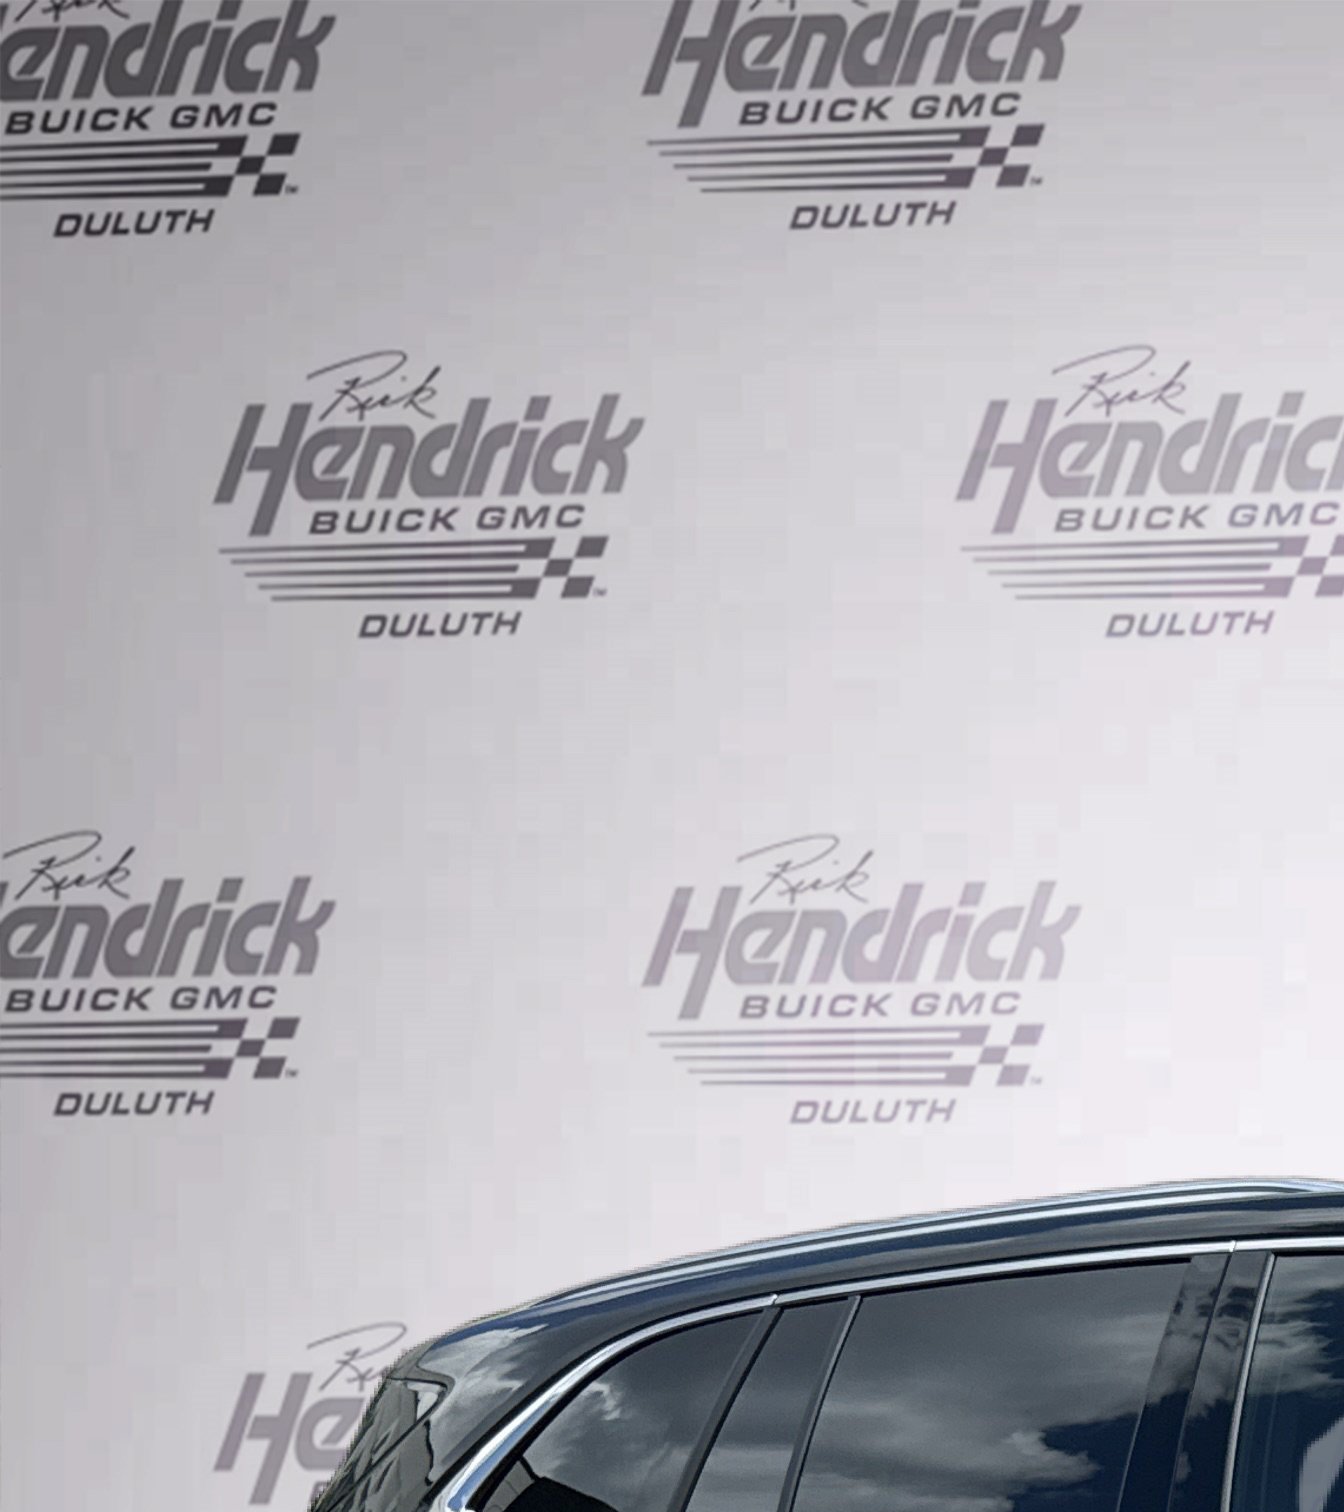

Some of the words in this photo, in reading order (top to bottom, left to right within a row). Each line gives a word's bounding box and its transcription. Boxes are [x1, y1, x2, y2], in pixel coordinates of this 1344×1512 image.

[0, 0, 336, 101] endrick
[641, 0, 1082, 128] Hendrick
[4, 106, 152, 135] BUICK
[168, 102, 278, 129] GMC
[739, 96, 893, 125] BUICK
[909, 93, 1022, 118] GMC
[53, 209, 215, 237] DULUTH
[789, 201, 957, 230] DULUTH
[212, 393, 646, 537] Hendrick
[309, 507, 460, 535] BUICK
[476, 504, 585, 530] GMC
[1054, 505, 1210, 533] BUICK
[1228, 502, 1340, 527] GMC
[358, 611, 522, 638] DULUTH
[1105, 610, 1275, 637] DULUTH
[0, 875, 336, 980] endrick
[641, 880, 1082, 1020] Hendrick
[4, 986, 154, 1013] BUICK
[168, 985, 278, 1010] GMC
[739, 993, 894, 1020] BUICK
[909, 991, 1022, 1017] GMC
[53, 1090, 215, 1116] DULUTH
[789, 1099, 957, 1125] DULUTH
